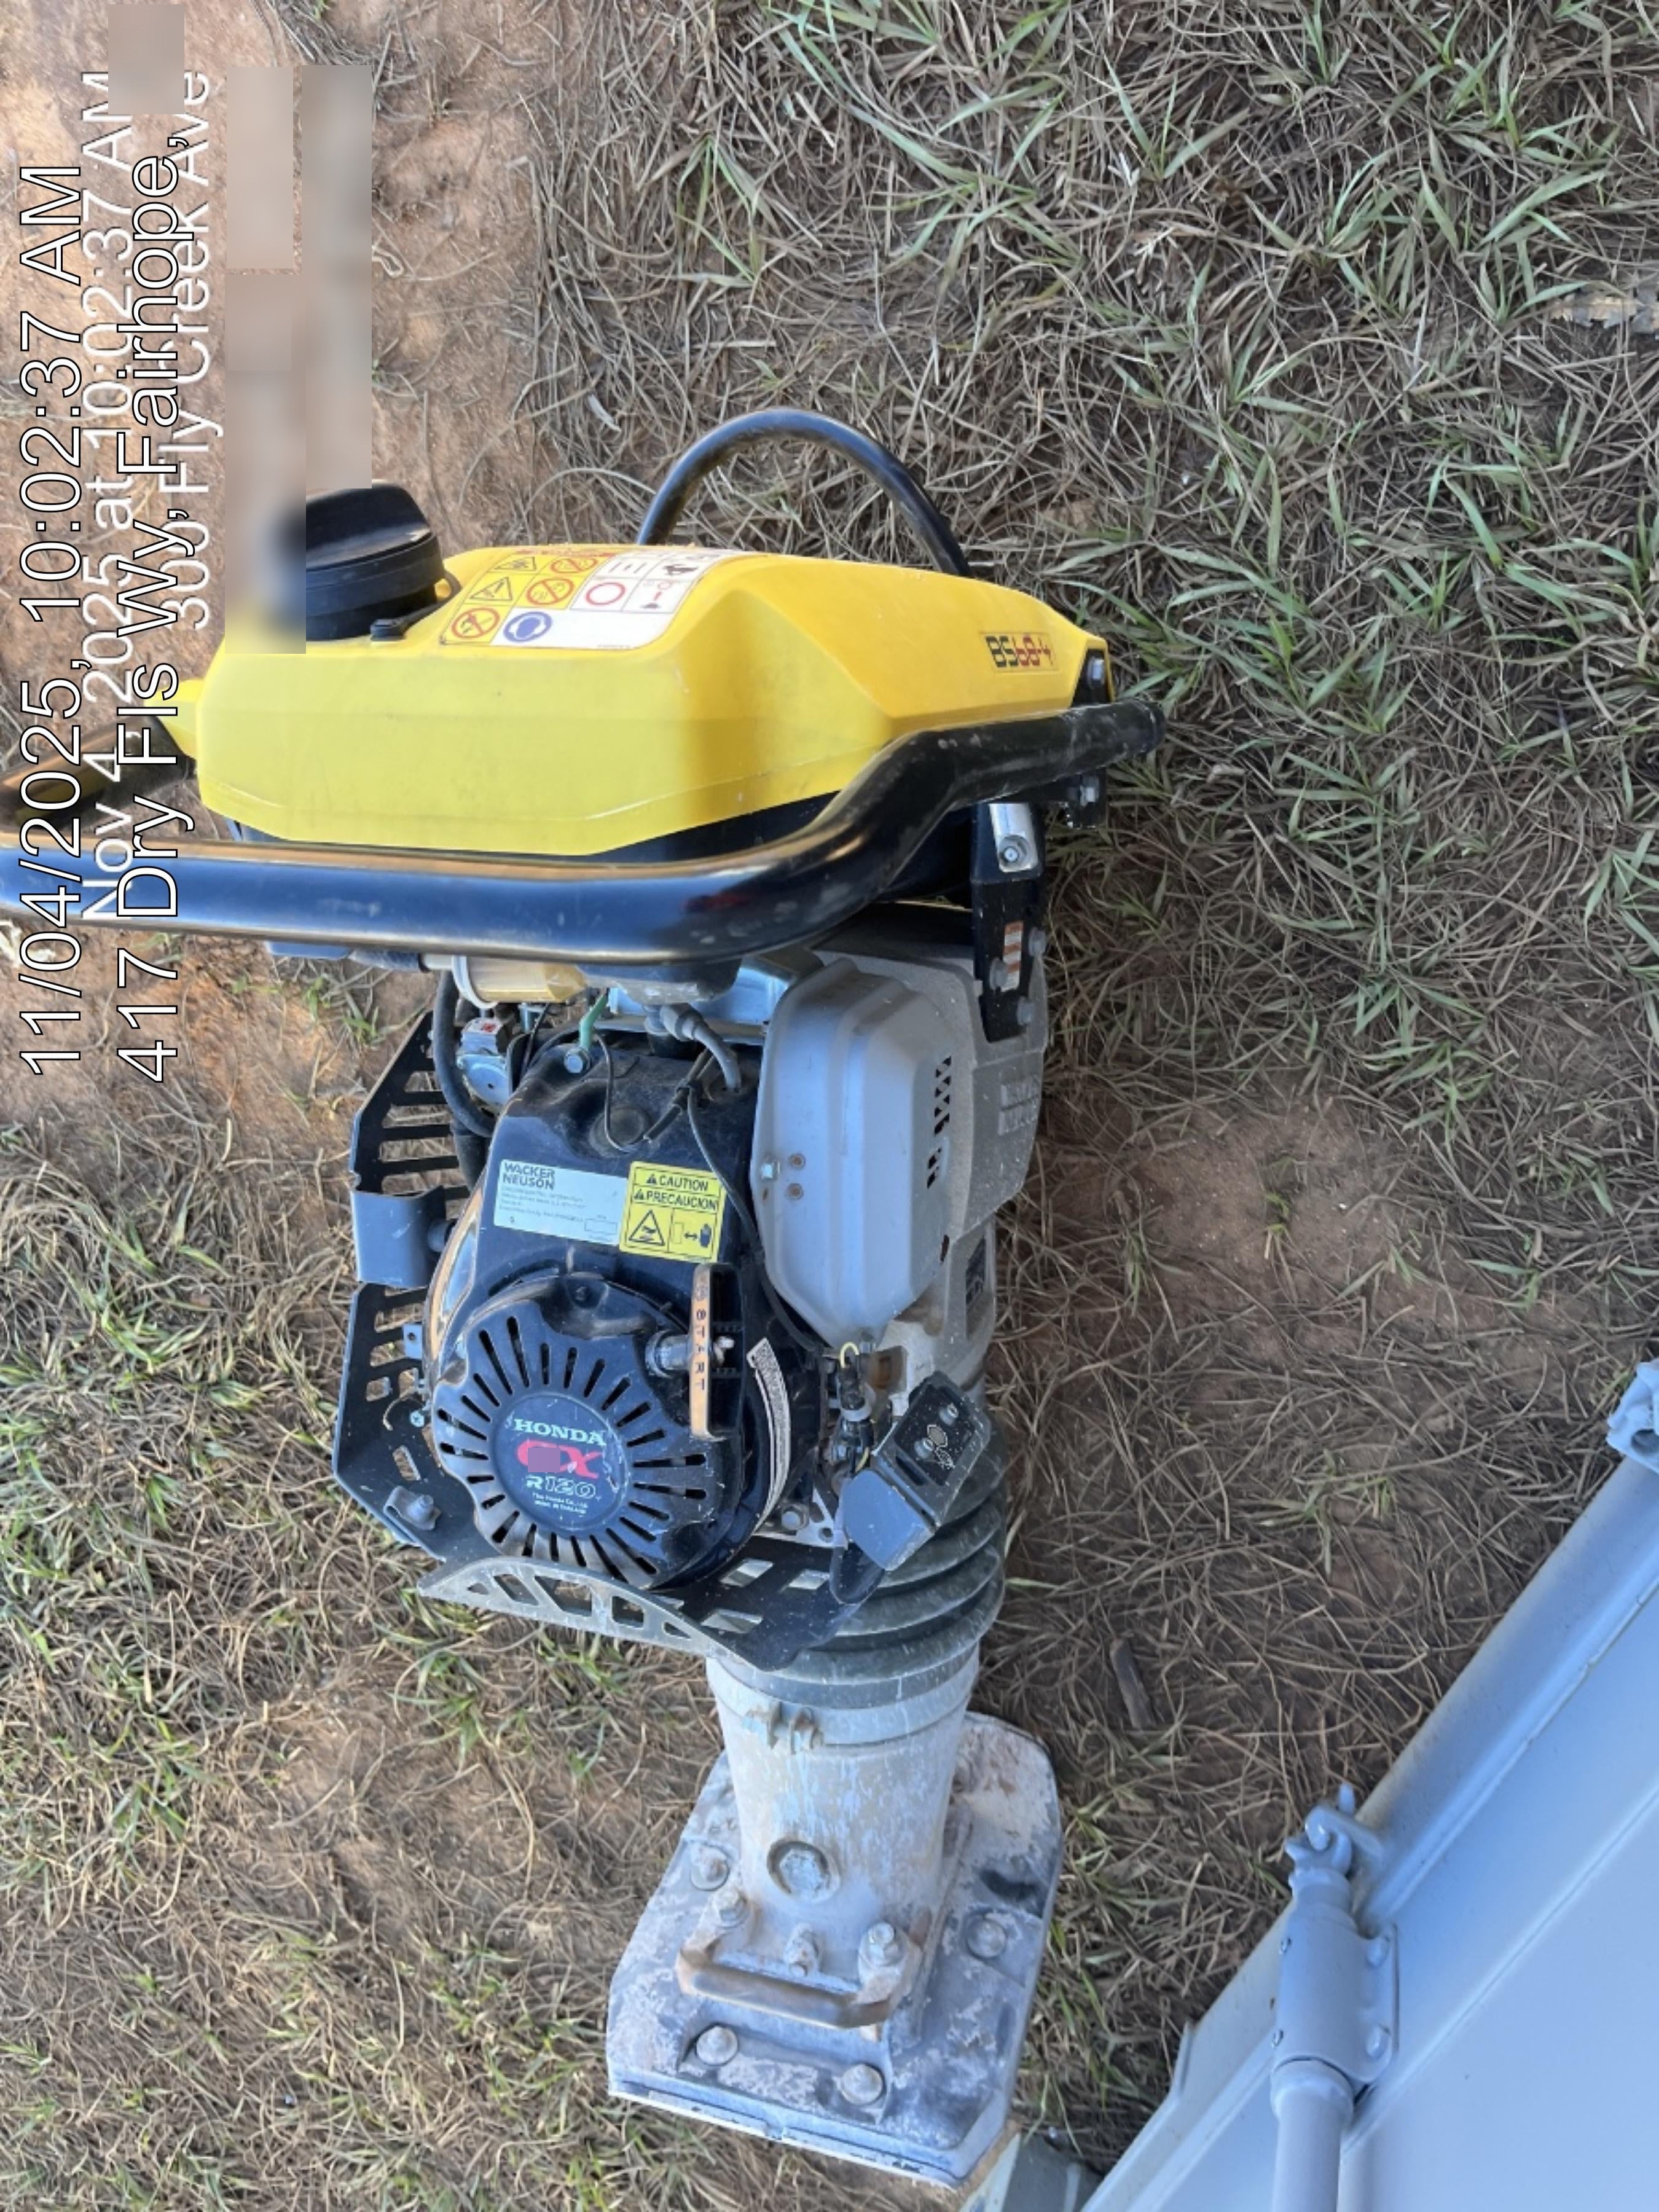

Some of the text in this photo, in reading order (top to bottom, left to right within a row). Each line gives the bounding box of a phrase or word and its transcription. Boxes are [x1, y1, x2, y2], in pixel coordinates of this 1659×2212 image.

[504, 1162, 555, 1179] WACKER
[503, 1173, 555, 1190] NEUSON
[659, 1175, 708, 1191] CAUTION
[514, 1419, 608, 1447] HONDA
